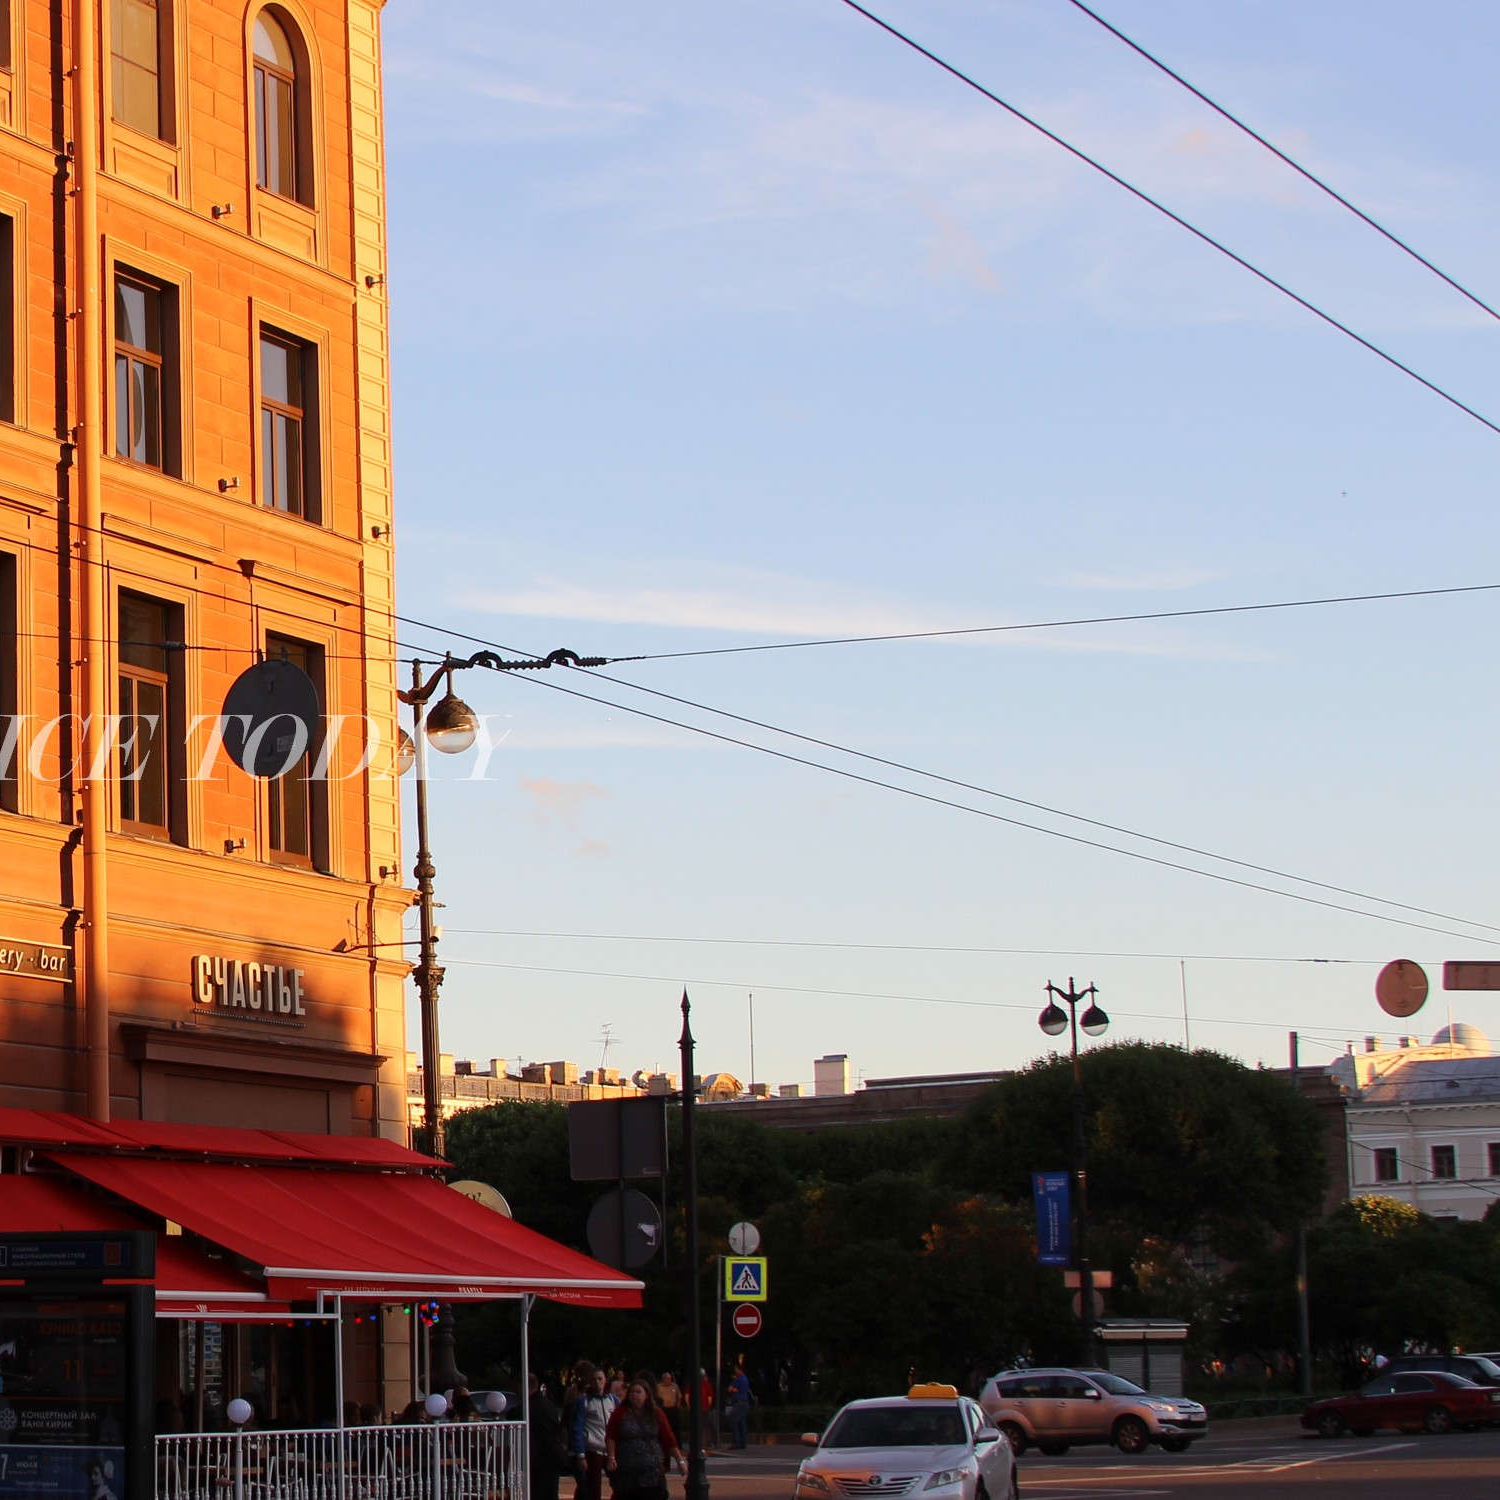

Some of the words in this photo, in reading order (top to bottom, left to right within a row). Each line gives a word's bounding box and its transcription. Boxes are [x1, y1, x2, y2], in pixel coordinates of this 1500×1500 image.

[40, 948, 66, 971] bar
[196, 954, 306, 1016] СЧАСТЬЕ
[63, 1359, 82, 1383] 11
[21, 1410, 78, 1421] КОНЦЕРТНЫЙ
[79, 1411, 97, 1420] ЗАЛ
[45, 1420, 73, 1429] КИРИК
[16, 1461, 38, 1469] ИЮЛЯ
